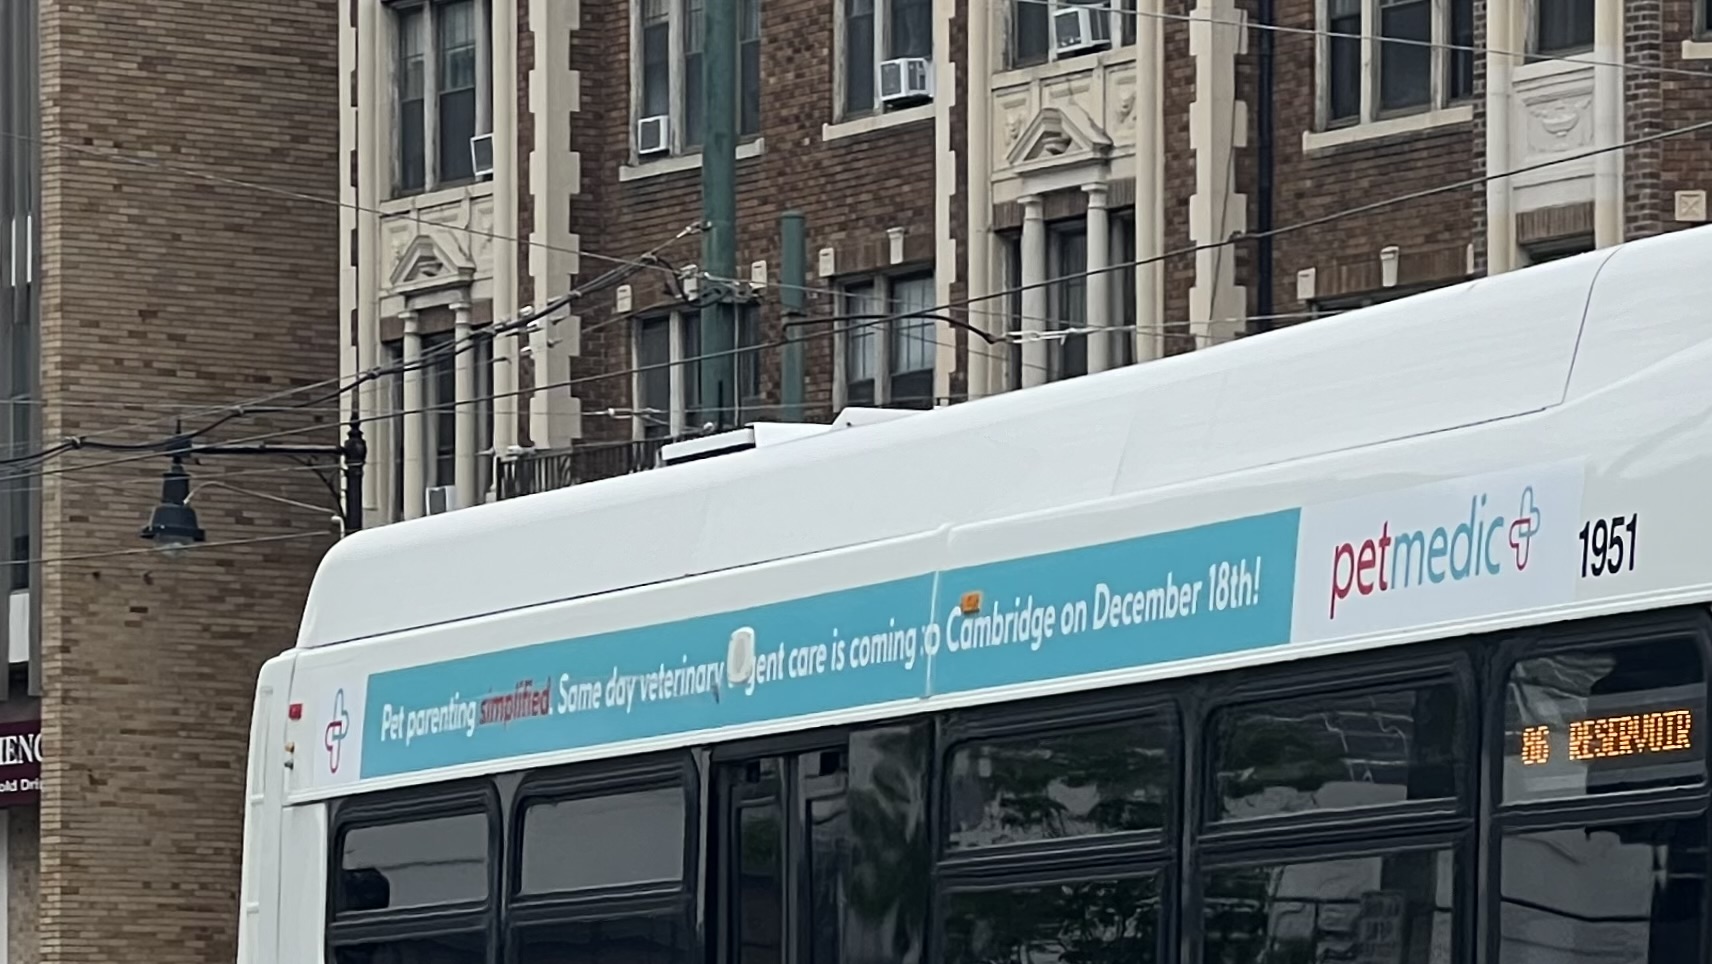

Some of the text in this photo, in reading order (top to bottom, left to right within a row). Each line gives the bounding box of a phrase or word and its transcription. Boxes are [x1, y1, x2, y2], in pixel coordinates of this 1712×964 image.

[1330, 494, 1504, 619] petmedic
[1578, 513, 1639, 578] 1951
[380, 703, 403, 742] Pet
[405, 692, 477, 747] parenting
[557, 673, 601, 715] Same
[605, 666, 638, 713] day
[639, 656, 726, 699] veterinary
[728, 641, 785, 697] gent
[788, 643, 828, 679] care
[831, 628, 844, 672] is
[849, 618, 917, 670] coming
[946, 595, 1055, 652] Cambridge
[1060, 602, 1087, 635] on
[1092, 571, 1202, 632] December
[1208, 556, 1262, 613] 18th!
[1521, 710, 1691, 765] 86 RESERVOIR
